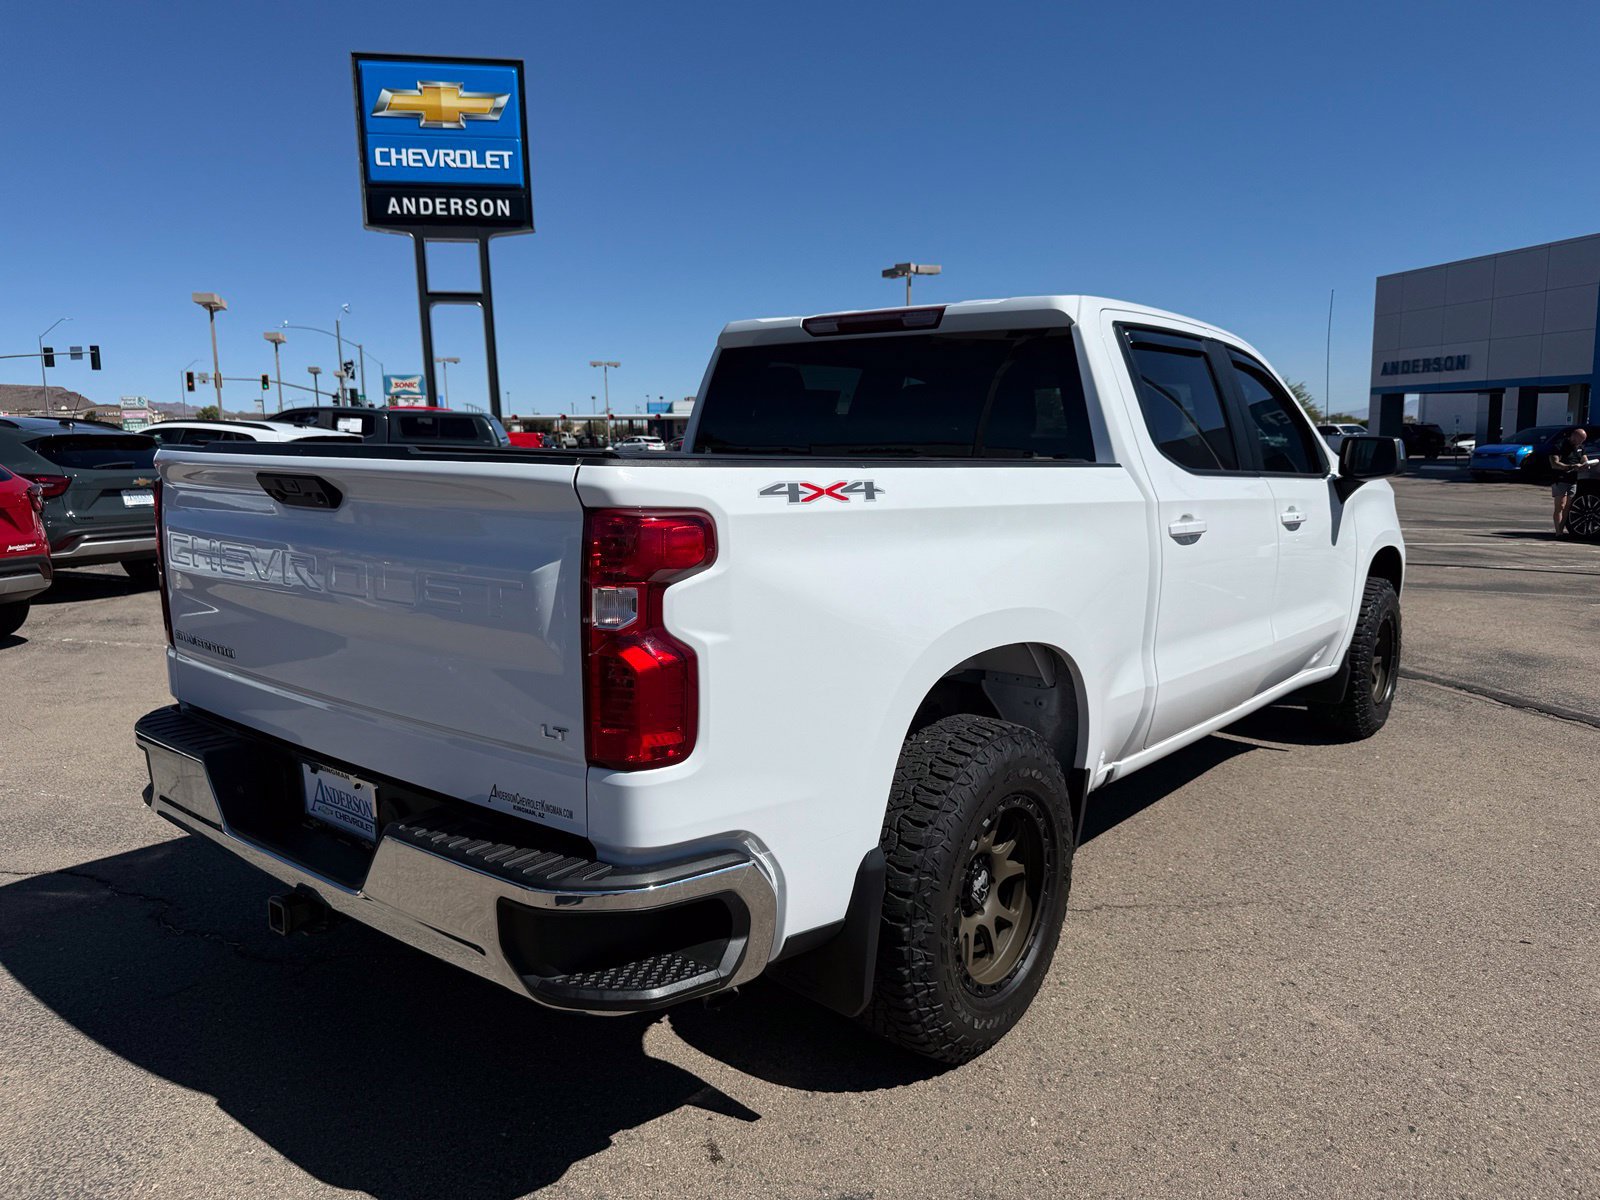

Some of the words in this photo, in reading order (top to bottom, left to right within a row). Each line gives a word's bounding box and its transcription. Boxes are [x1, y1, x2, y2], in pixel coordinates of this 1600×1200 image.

[374, 147, 513, 169] CHEVROLET
[387, 196, 511, 217] ANDERSON
[1380, 354, 1471, 377] ANDERSON
[394, 381, 418, 389] SONIC
[168, 529, 524, 618] CHEVROLET
[540, 723, 570, 741] LT
[335, 810, 374, 834] CHEVROLET
